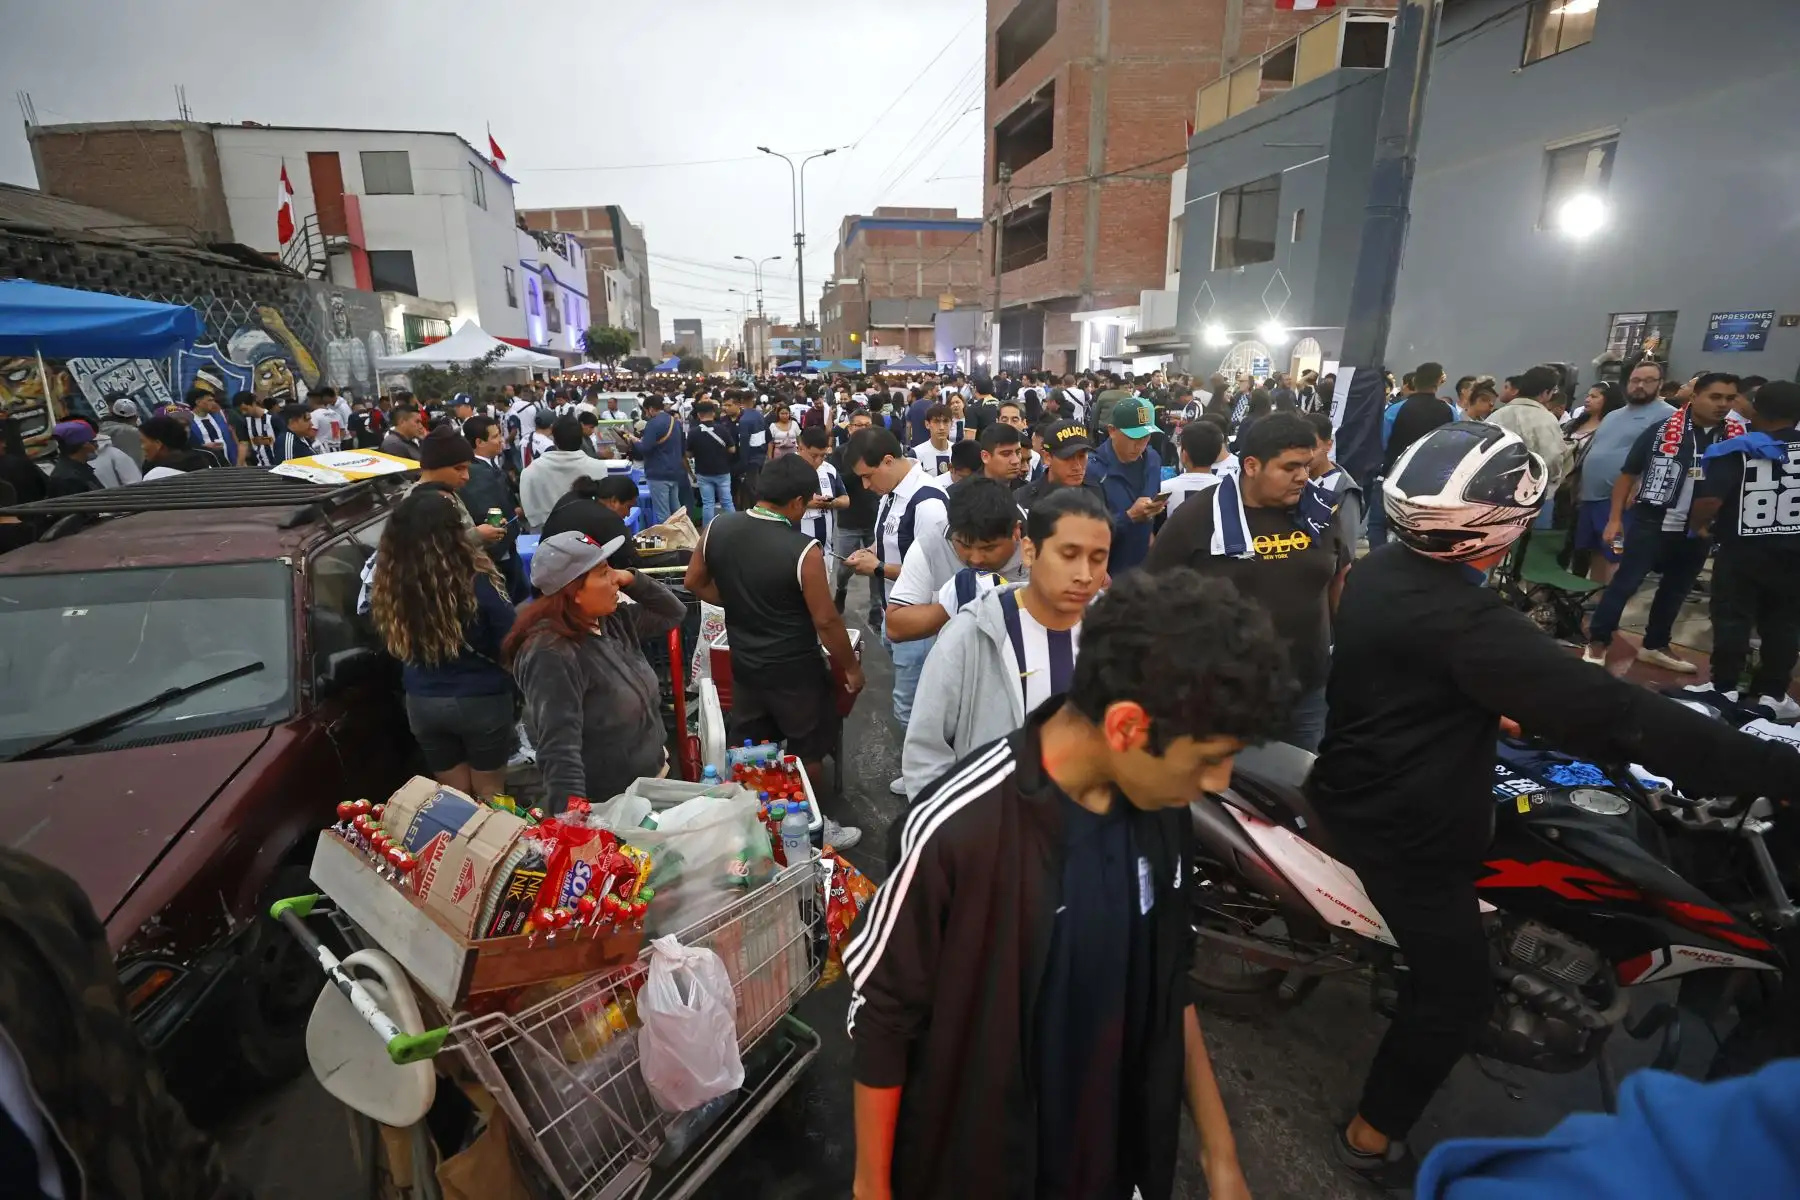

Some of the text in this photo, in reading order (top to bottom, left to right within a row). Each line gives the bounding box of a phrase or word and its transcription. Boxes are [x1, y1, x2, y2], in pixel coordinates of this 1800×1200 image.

[1712, 312, 1773, 320] IMPRESIONES
[435, 831, 451, 863] SAN
[508, 875, 526, 900] NIK
[523, 877, 543, 901] NIK
[562, 871, 573, 891] SAN
[1316, 888, 1382, 930] X-PLORER 200X
